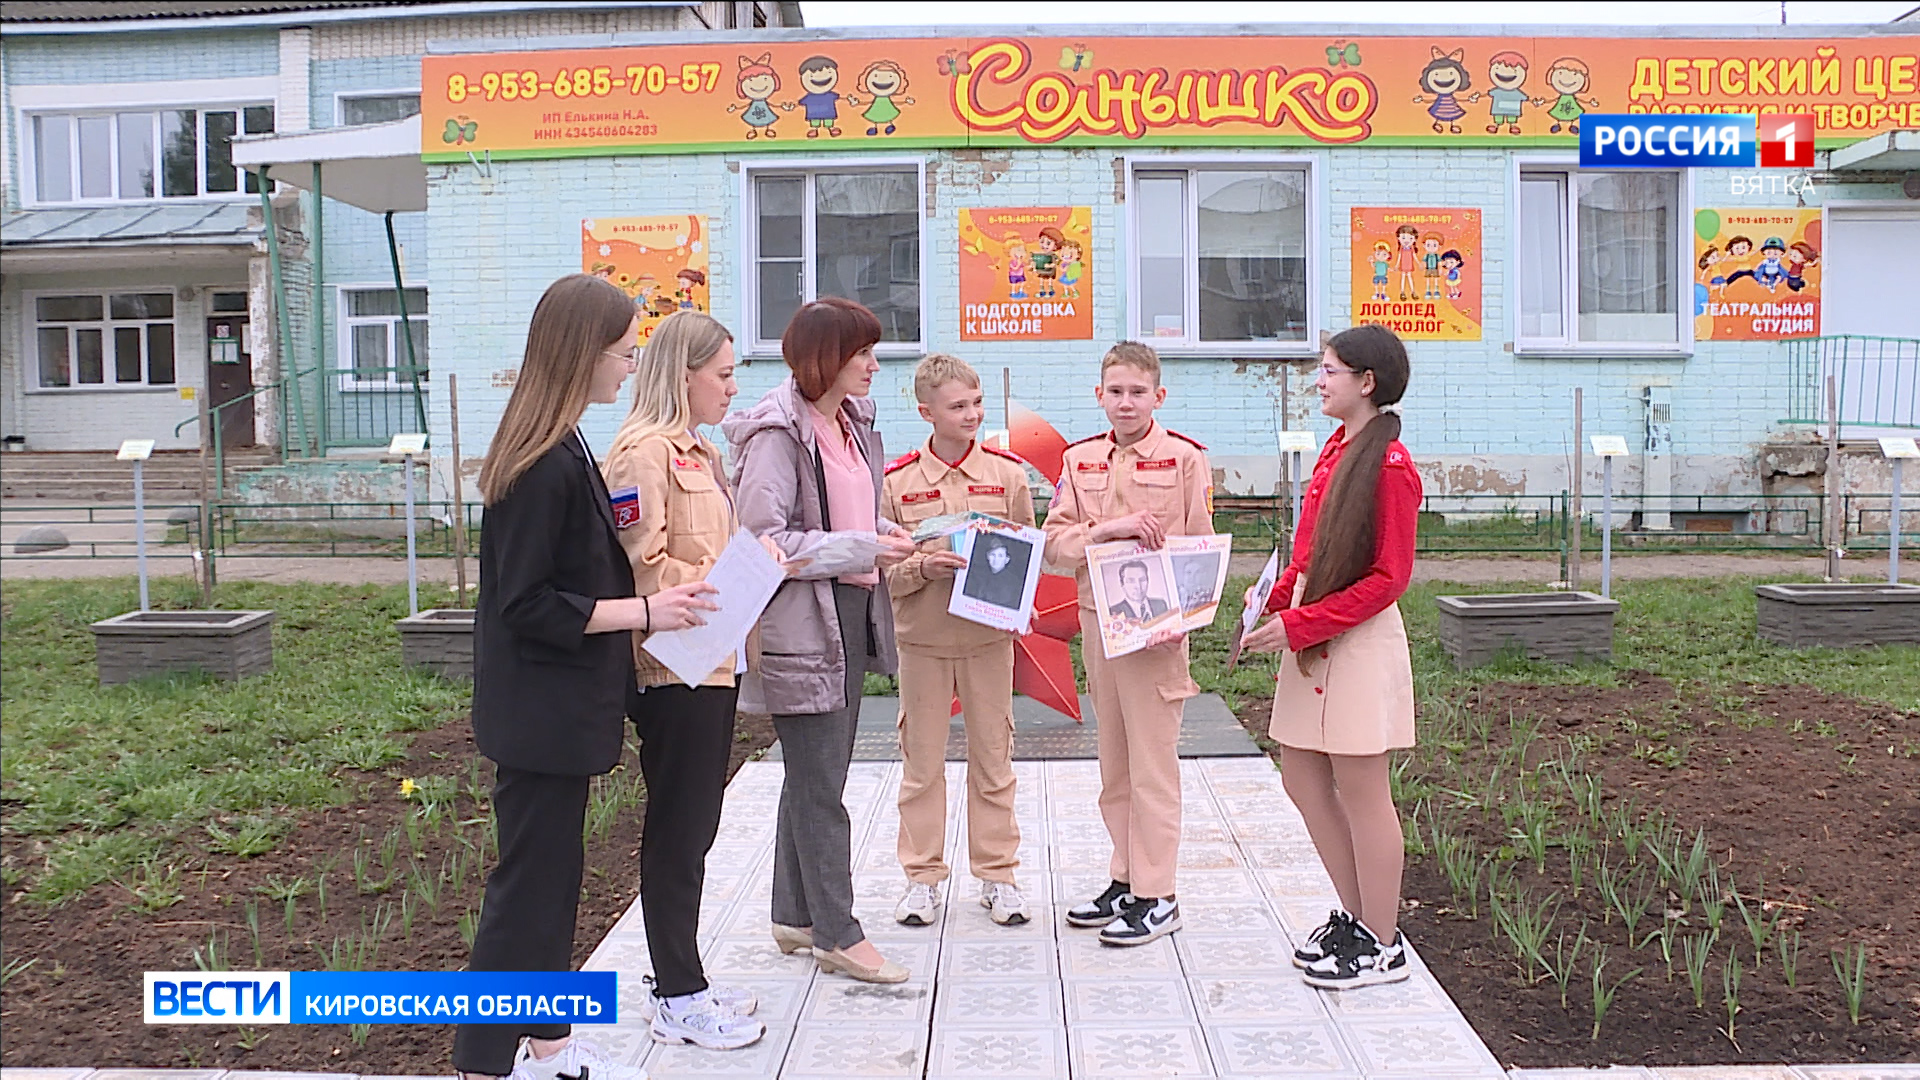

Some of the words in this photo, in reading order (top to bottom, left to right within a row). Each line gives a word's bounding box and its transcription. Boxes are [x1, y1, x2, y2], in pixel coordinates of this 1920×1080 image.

[1629, 46, 1840, 101] ДЕТСКИЙ
[447, 62, 721, 103] 8-953-685-70-57
[950, 38, 1377, 143] Солнышко
[542, 112, 561, 124] ИП
[534, 128, 562, 139] ИНН
[965, 303, 1076, 319] ПОДГОТОВКА
[1359, 303, 1436, 318] ЛОГОПЕД
[1700, 303, 1815, 317] ТЕАТРАЛЬНАЯ
[965, 320, 978, 334] К
[980, 319, 1043, 334] ШКОЛЕ
[1360, 319, 1445, 333] ПИХОЛОГ
[1752, 319, 1815, 334] СТУДИЯ
